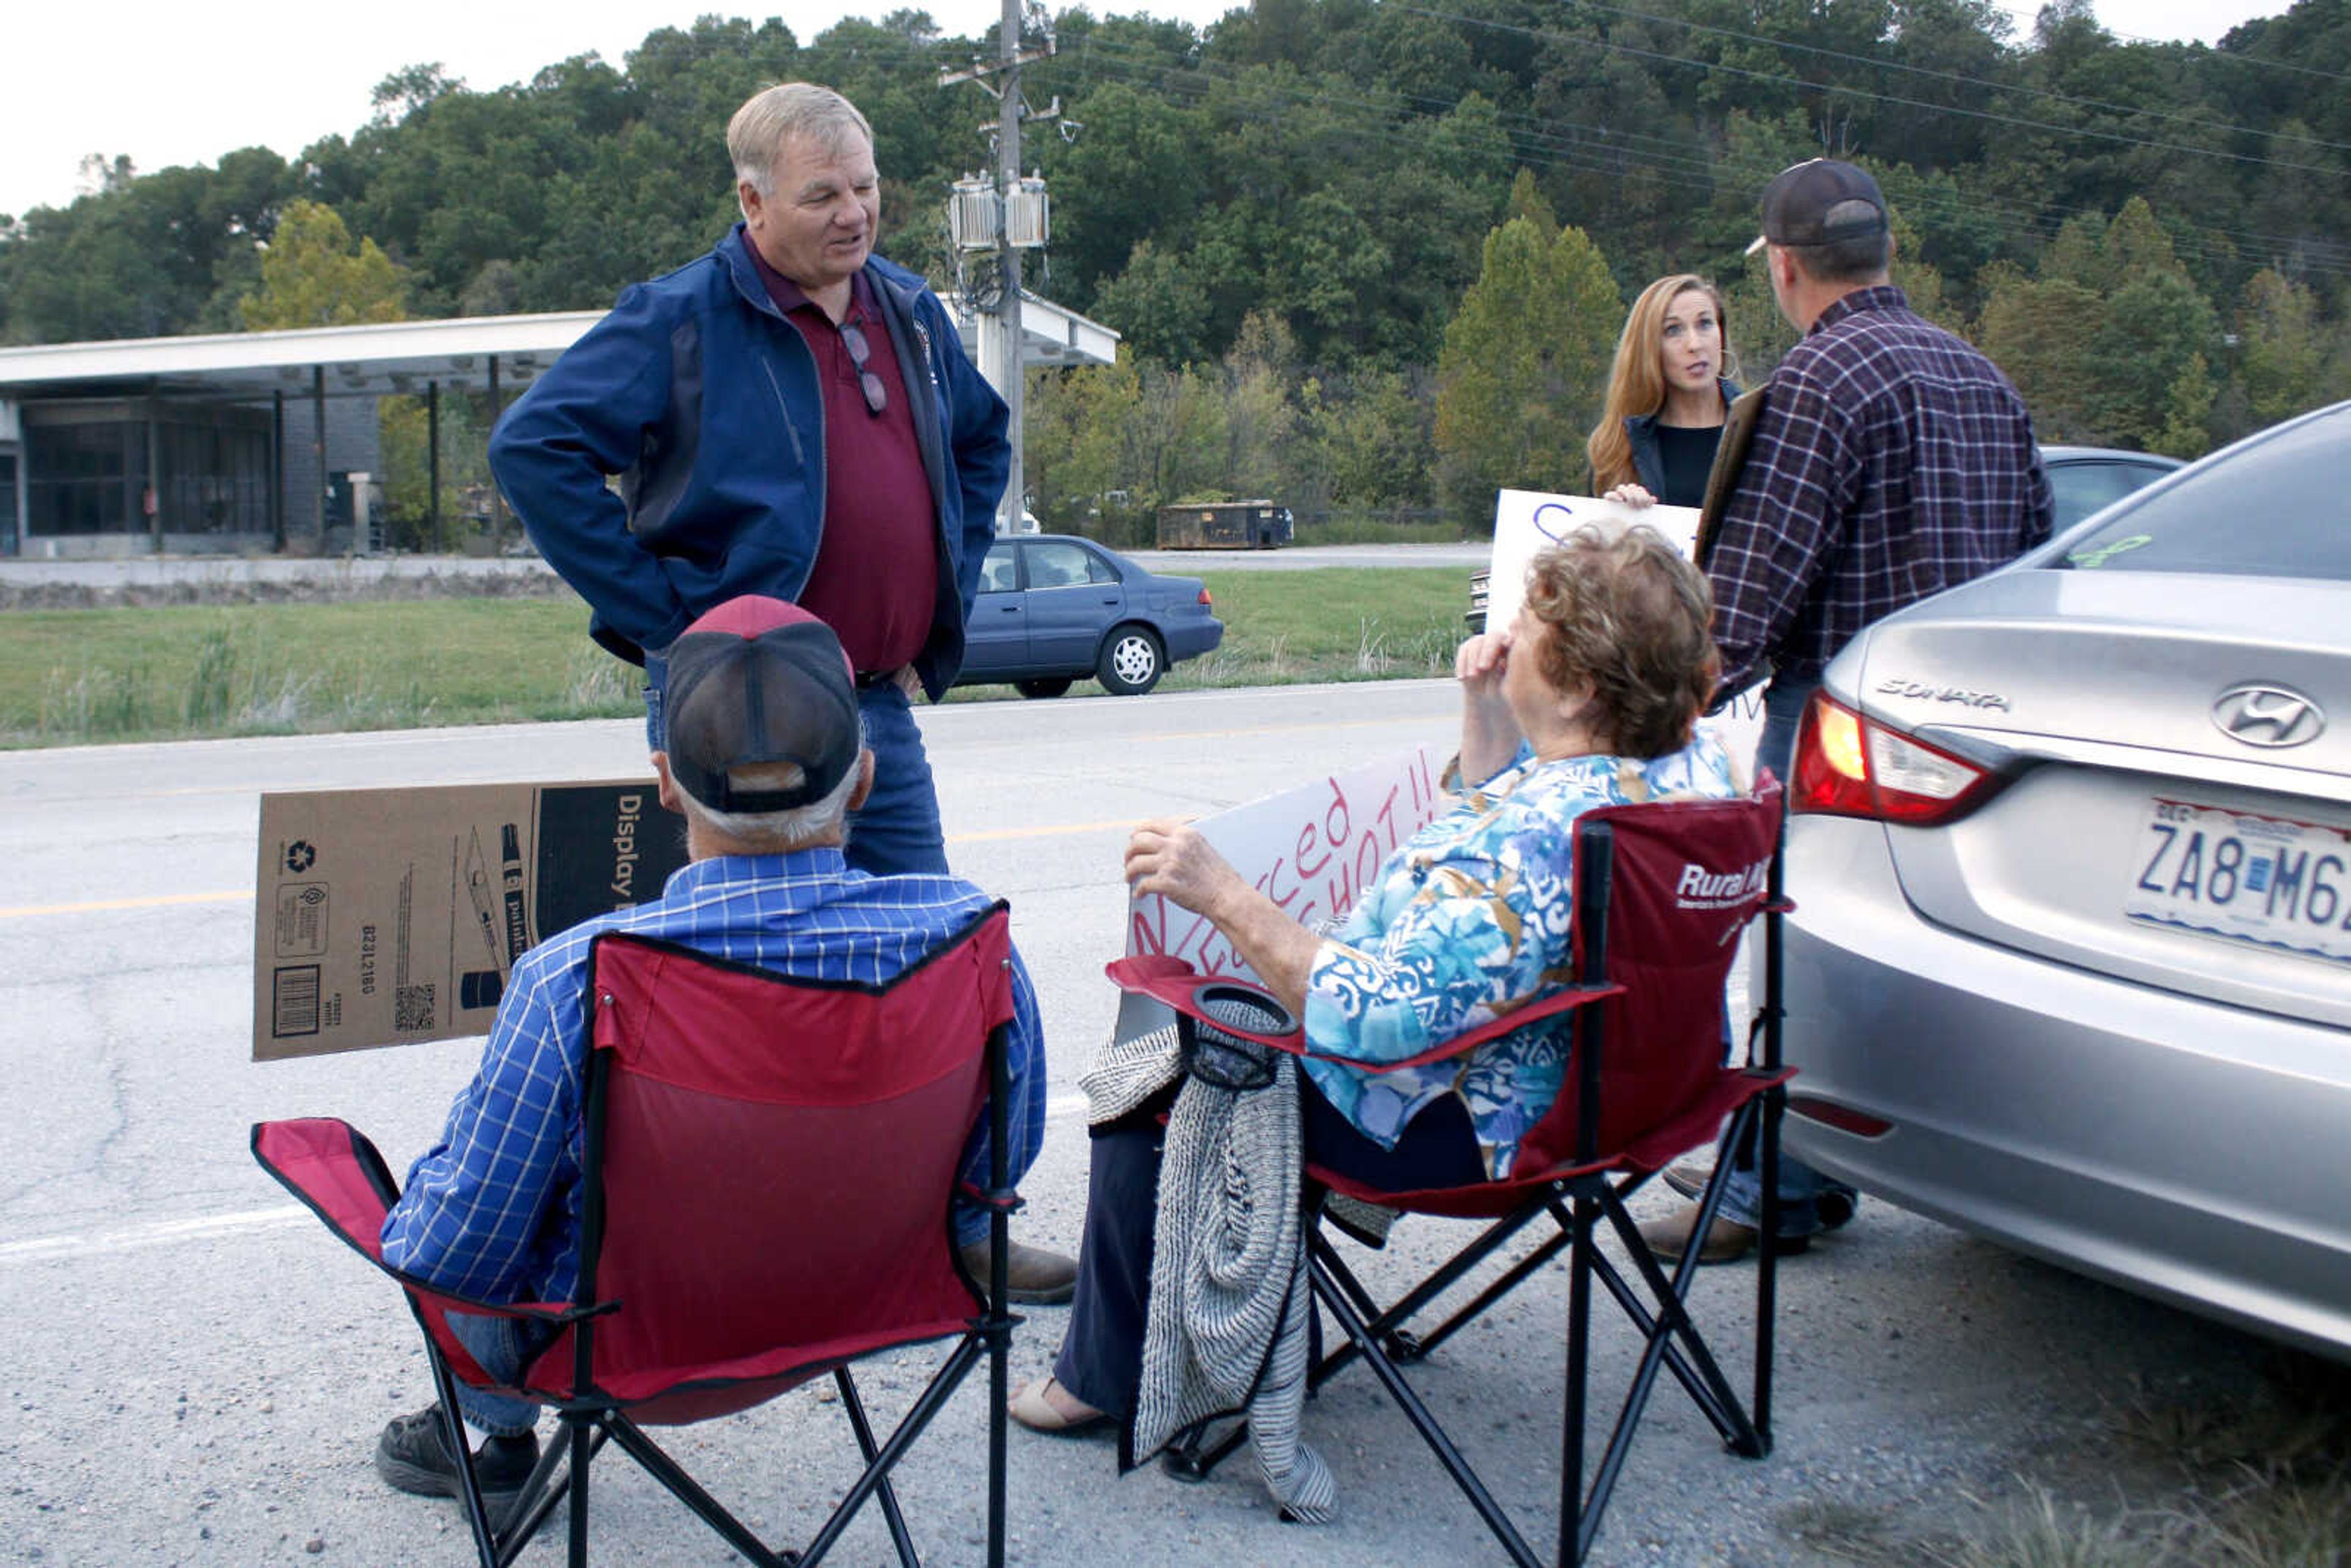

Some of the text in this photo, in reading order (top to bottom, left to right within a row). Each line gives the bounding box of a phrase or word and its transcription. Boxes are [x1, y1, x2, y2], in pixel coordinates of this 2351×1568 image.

[1877, 679, 2010, 713] SONATA
[610, 795, 642, 898] Display
[1676, 863, 1750, 896] Rural
[2138, 823, 2243, 905] ZA8
[2267, 846, 2351, 931] M6
